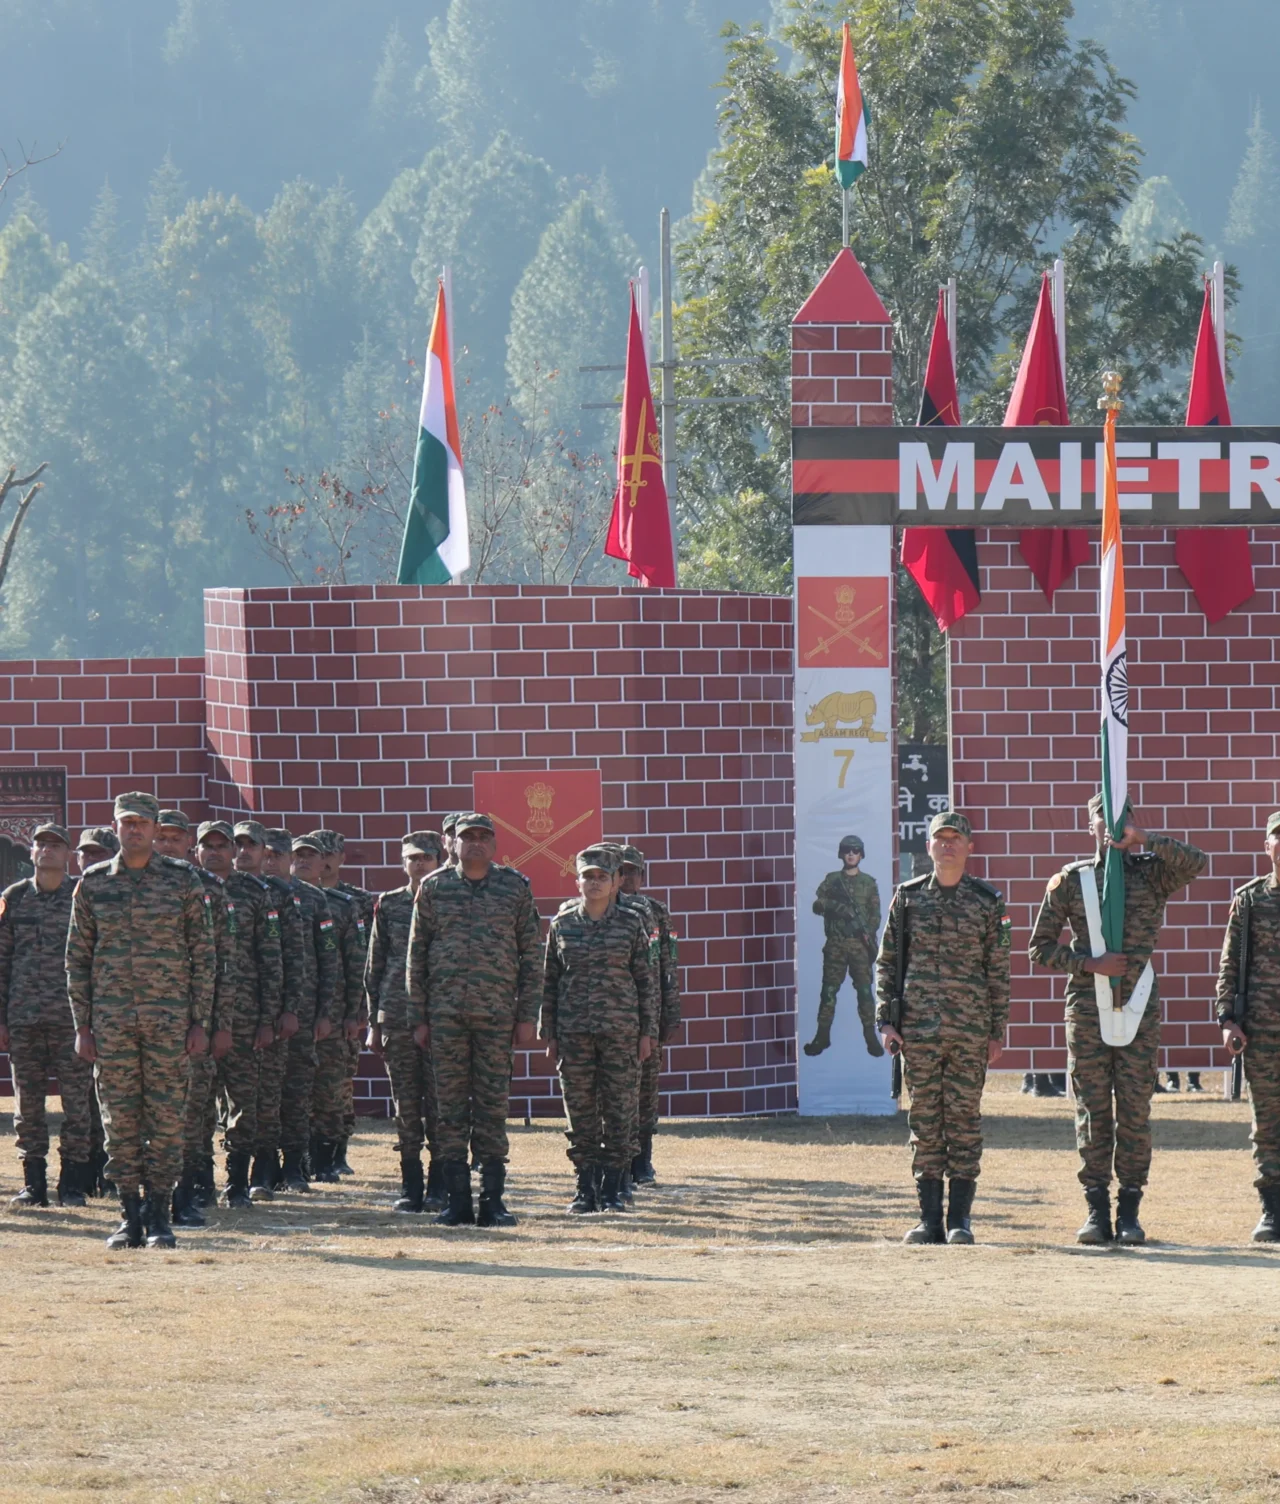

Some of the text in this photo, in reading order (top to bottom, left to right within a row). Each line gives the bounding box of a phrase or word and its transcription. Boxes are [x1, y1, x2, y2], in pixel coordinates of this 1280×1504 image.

[819, 729, 846, 737] ASSAM
[834, 750, 854, 788] 7
[898, 787, 949, 812] ने क
